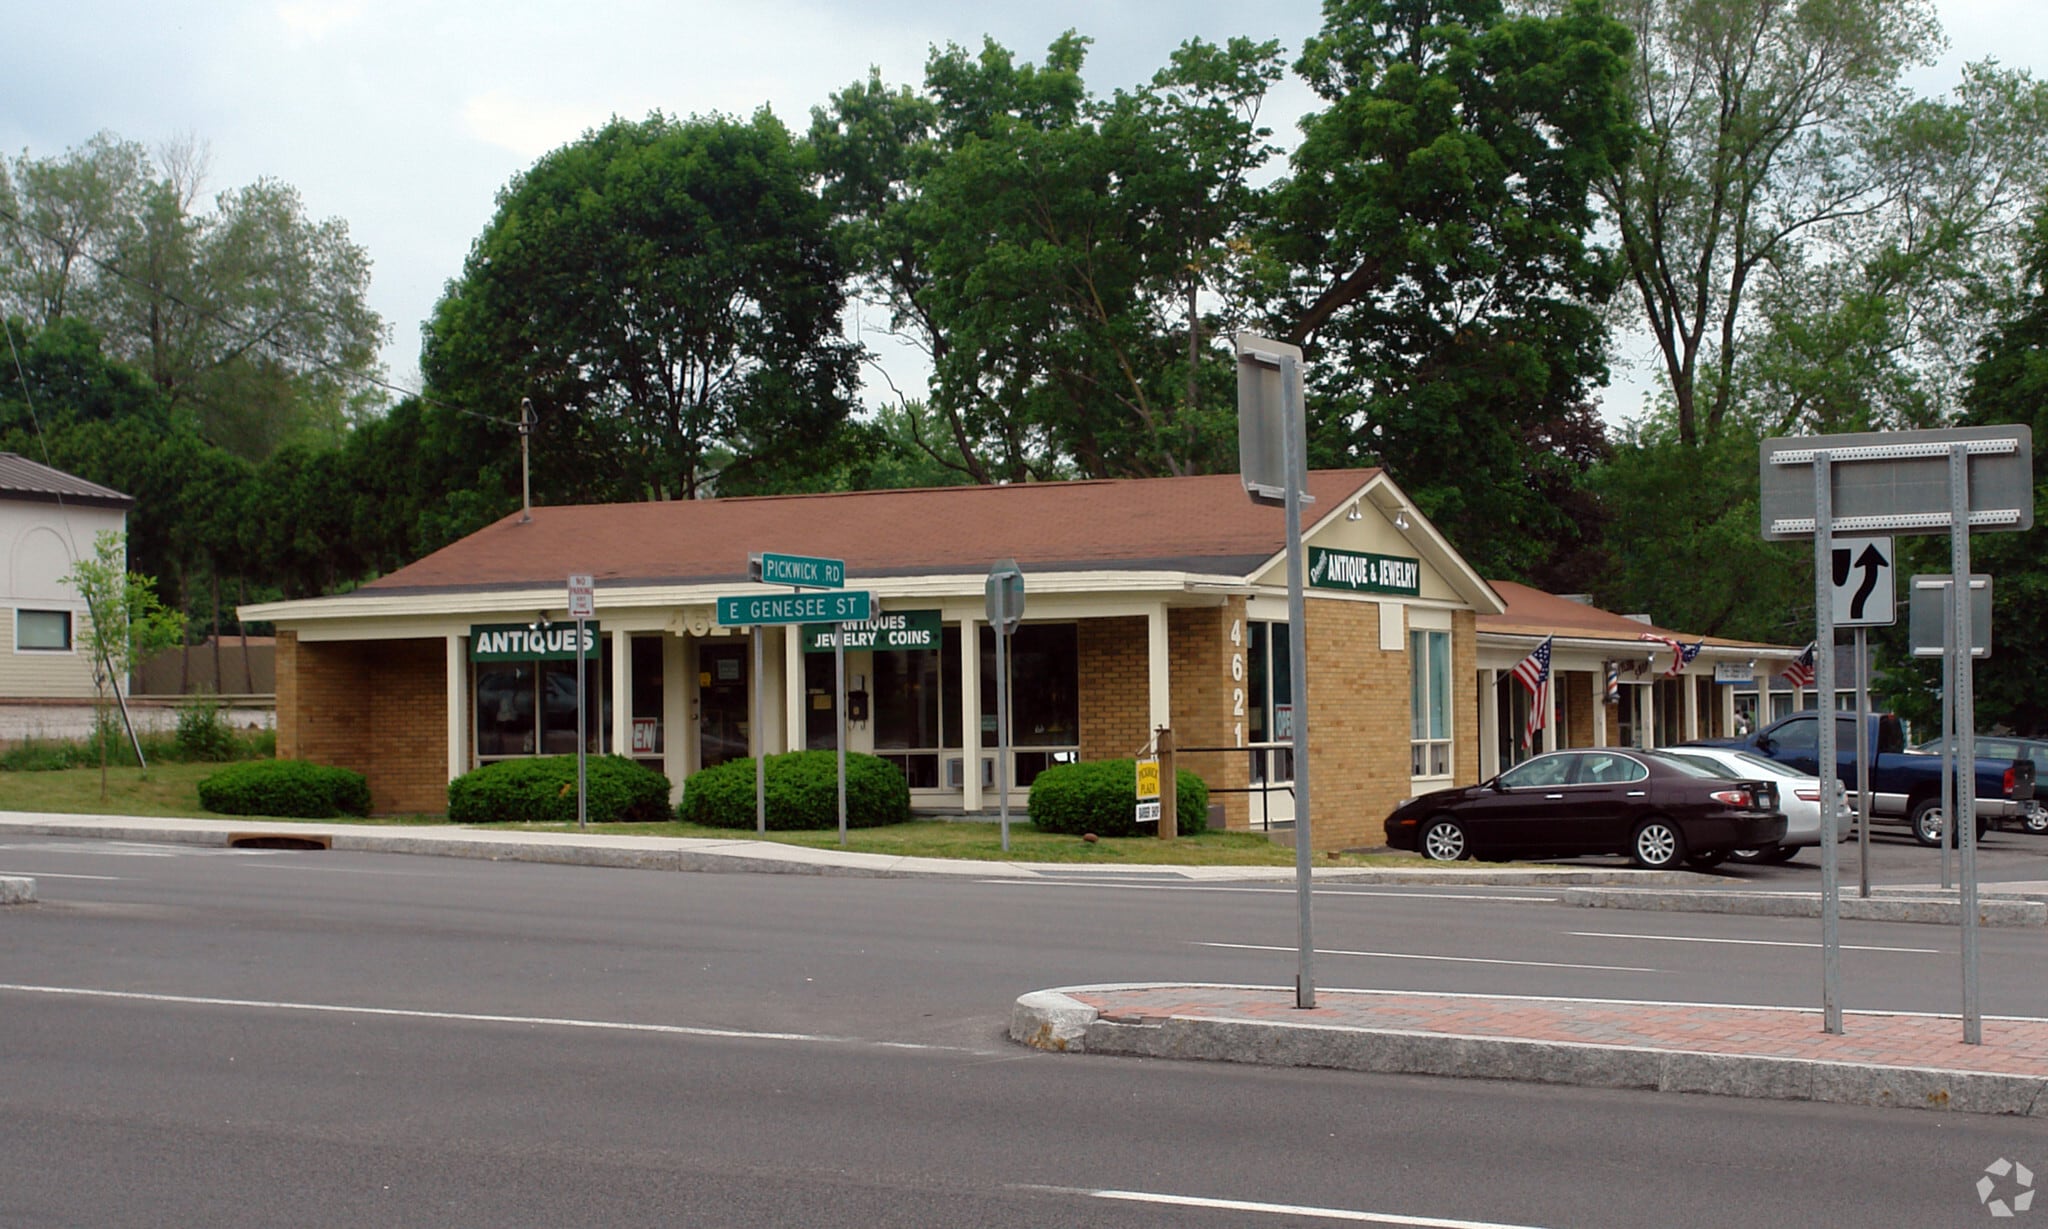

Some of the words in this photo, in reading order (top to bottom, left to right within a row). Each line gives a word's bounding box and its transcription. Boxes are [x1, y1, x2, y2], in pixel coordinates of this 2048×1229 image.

[767, 560, 818, 580] PICKWICK
[826, 565, 840, 582] RD
[1328, 554, 1368, 588] ANTIQUE
[1370, 563, 1377, 582] &
[1379, 560, 1418, 588] JEWELRY
[730, 603, 739, 619] E
[751, 599, 826, 618] GENESEE
[836, 598, 857, 615] ST
[476, 629, 594, 654] ANTIQUES
[888, 630, 930, 645] COINS
[1231, 619, 1244, 749] 4621
